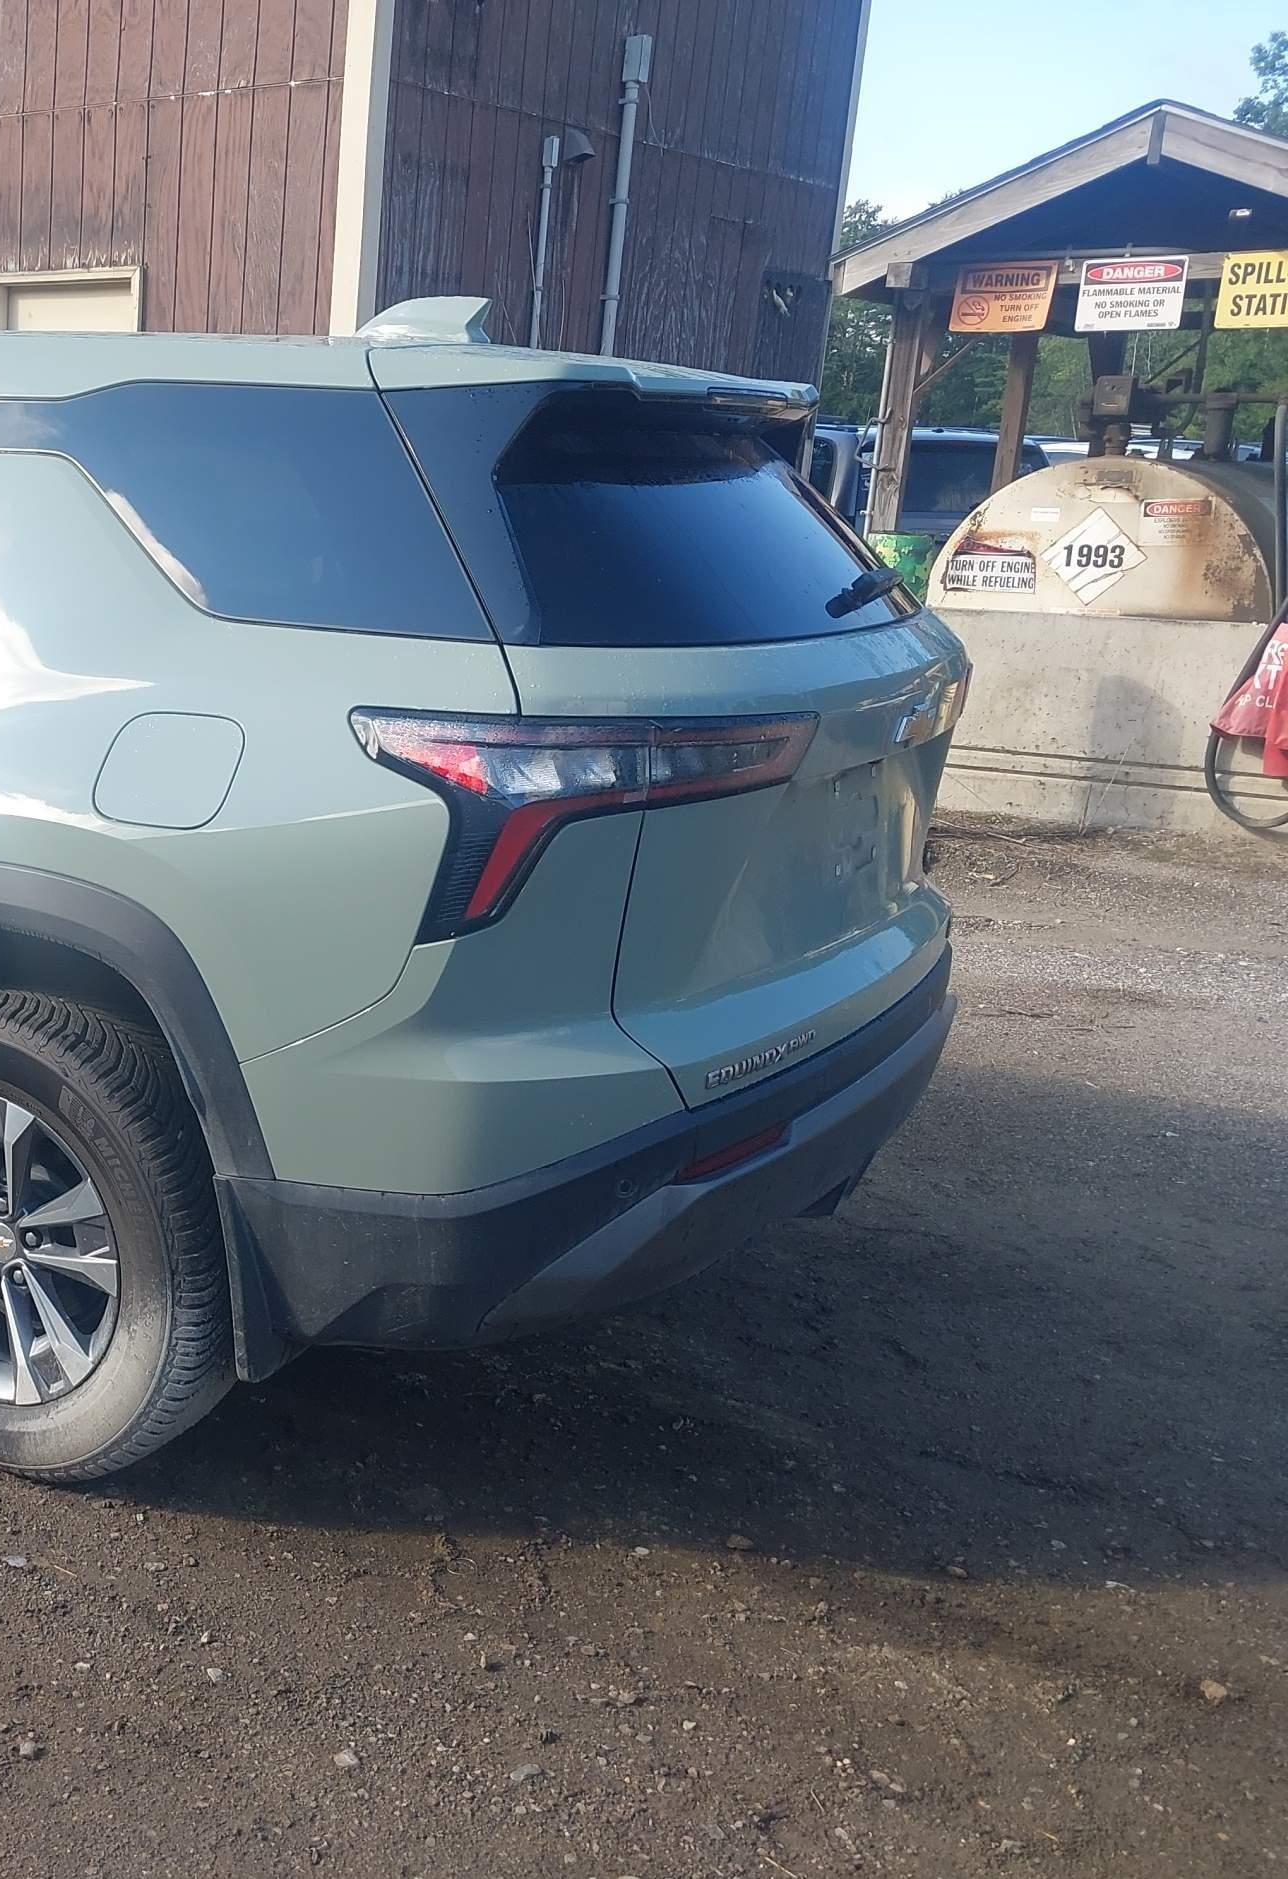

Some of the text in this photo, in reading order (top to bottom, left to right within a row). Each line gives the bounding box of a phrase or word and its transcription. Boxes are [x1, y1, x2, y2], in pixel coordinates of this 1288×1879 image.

[1102, 266, 1166, 280] DANGER
[1228, 261, 1286, 285] SPILL
[971, 273, 1041, 288] WARNING
[993, 292, 1047, 302] NO SMOKING
[1081, 286, 1182, 297] FLAMMABLE MATERIAL
[999, 303, 1040, 312] TURN OFF
[1094, 299, 1165, 309] NO SMOKING OR
[1230, 292, 1288, 317] STATI
[1002, 314, 1033, 323] ENGINE
[1098, 309, 1159, 319] OPEN FLAMES
[1153, 504, 1201, 514] DANGER
[1063, 543, 1125, 569] 1993
[951, 559, 1036, 574] TURN OFF ENGINE
[947, 573, 1034, 589] WHILE REFUELING
[706, 1044, 786, 1089] EQUINOX
